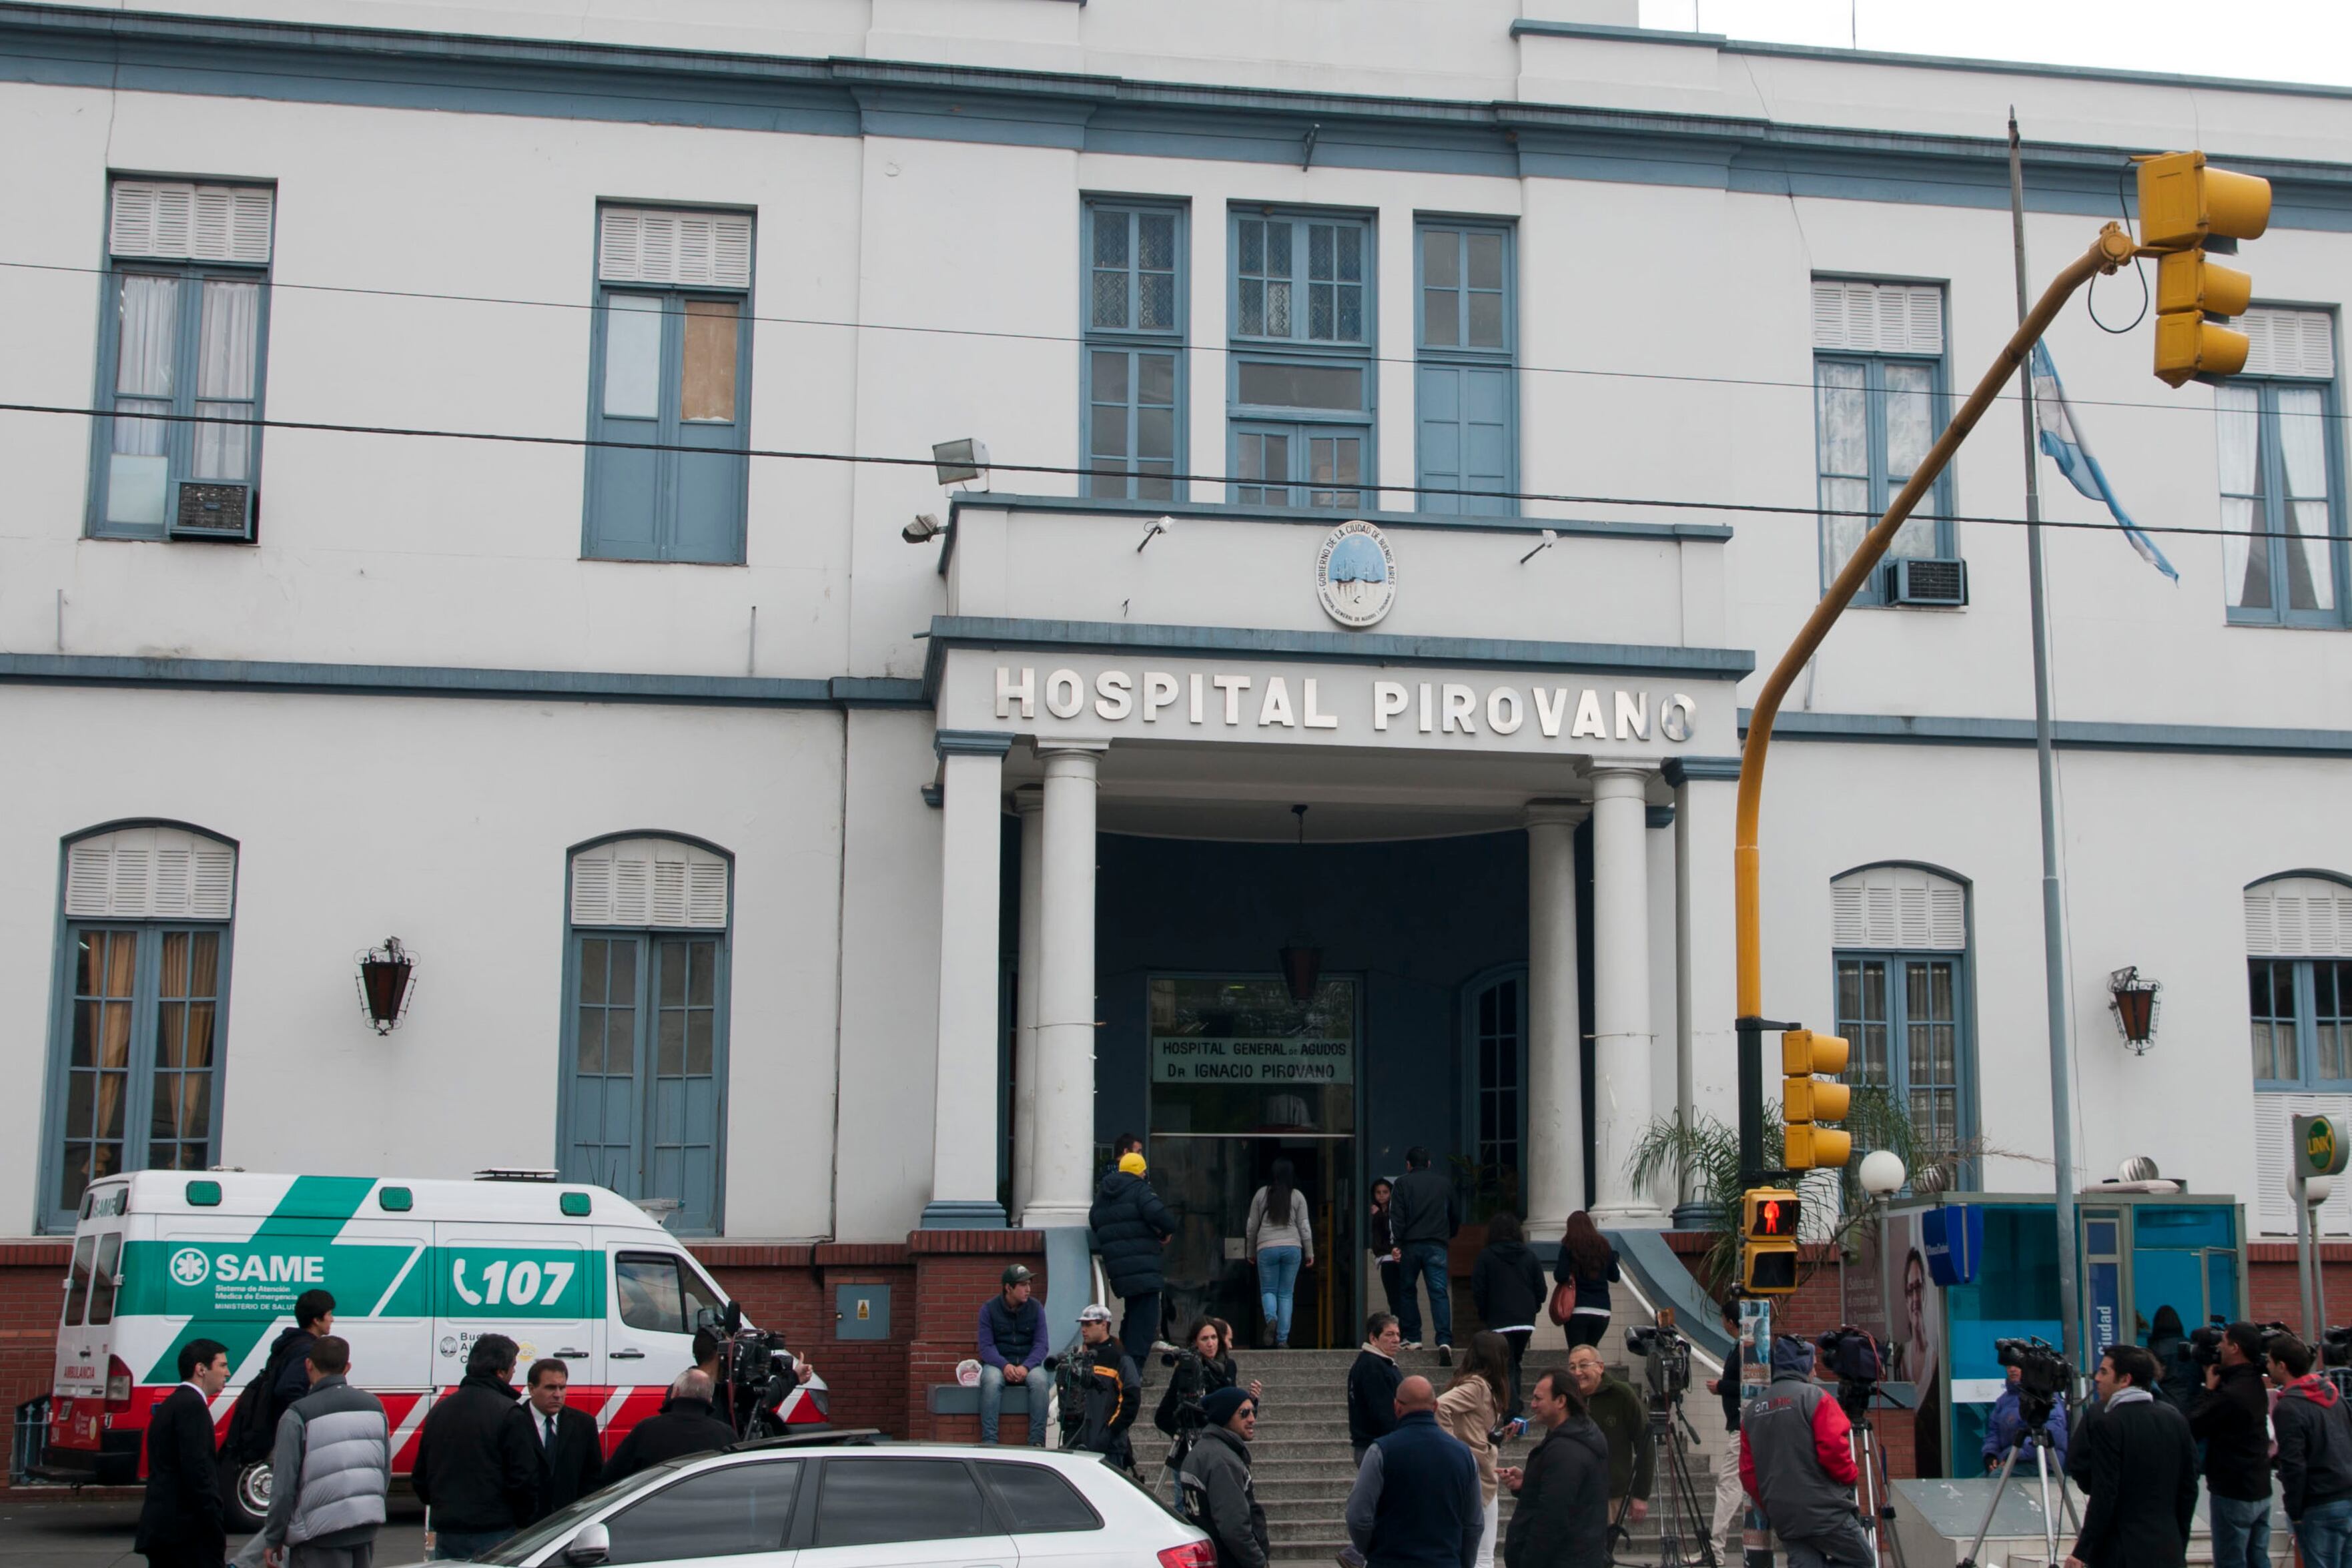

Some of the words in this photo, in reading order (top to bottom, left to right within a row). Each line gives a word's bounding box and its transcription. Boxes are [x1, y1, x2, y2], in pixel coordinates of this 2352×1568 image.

[1318, 548, 1330, 586] GOBIERNO
[1326, 538, 1337, 549] DE
[1335, 529, 1344, 540] LA
[1345, 524, 1371, 534] CIUDAD
[1371, 530, 1381, 540] DE
[1379, 538, 1393, 564] BUENOS
[1387, 565, 1395, 586] AIRES
[1324, 592, 1335, 611] HOSPITAL
[1335, 609, 1353, 621] GENERAL
[996, 668, 1338, 728] HOSPITAL
[1373, 681, 1697, 742] PIROVANO
[1162, 1042, 1226, 1056] HOSPITAL
[1233, 1042, 1287, 1056] GENERAL
[1300, 1043, 1346, 1056] AGUDOS
[1195, 1064, 1253, 1078] IGNACIO
[1262, 1064, 1335, 1078] PIROVANO
[2306, 1136, 2331, 1155] LINK
[216, 1254, 324, 1282] SAME
[216, 1284, 246, 1292] Sistema
[482, 1260, 575, 1306] 107
[255, 1292, 298, 1301] Emergencia
